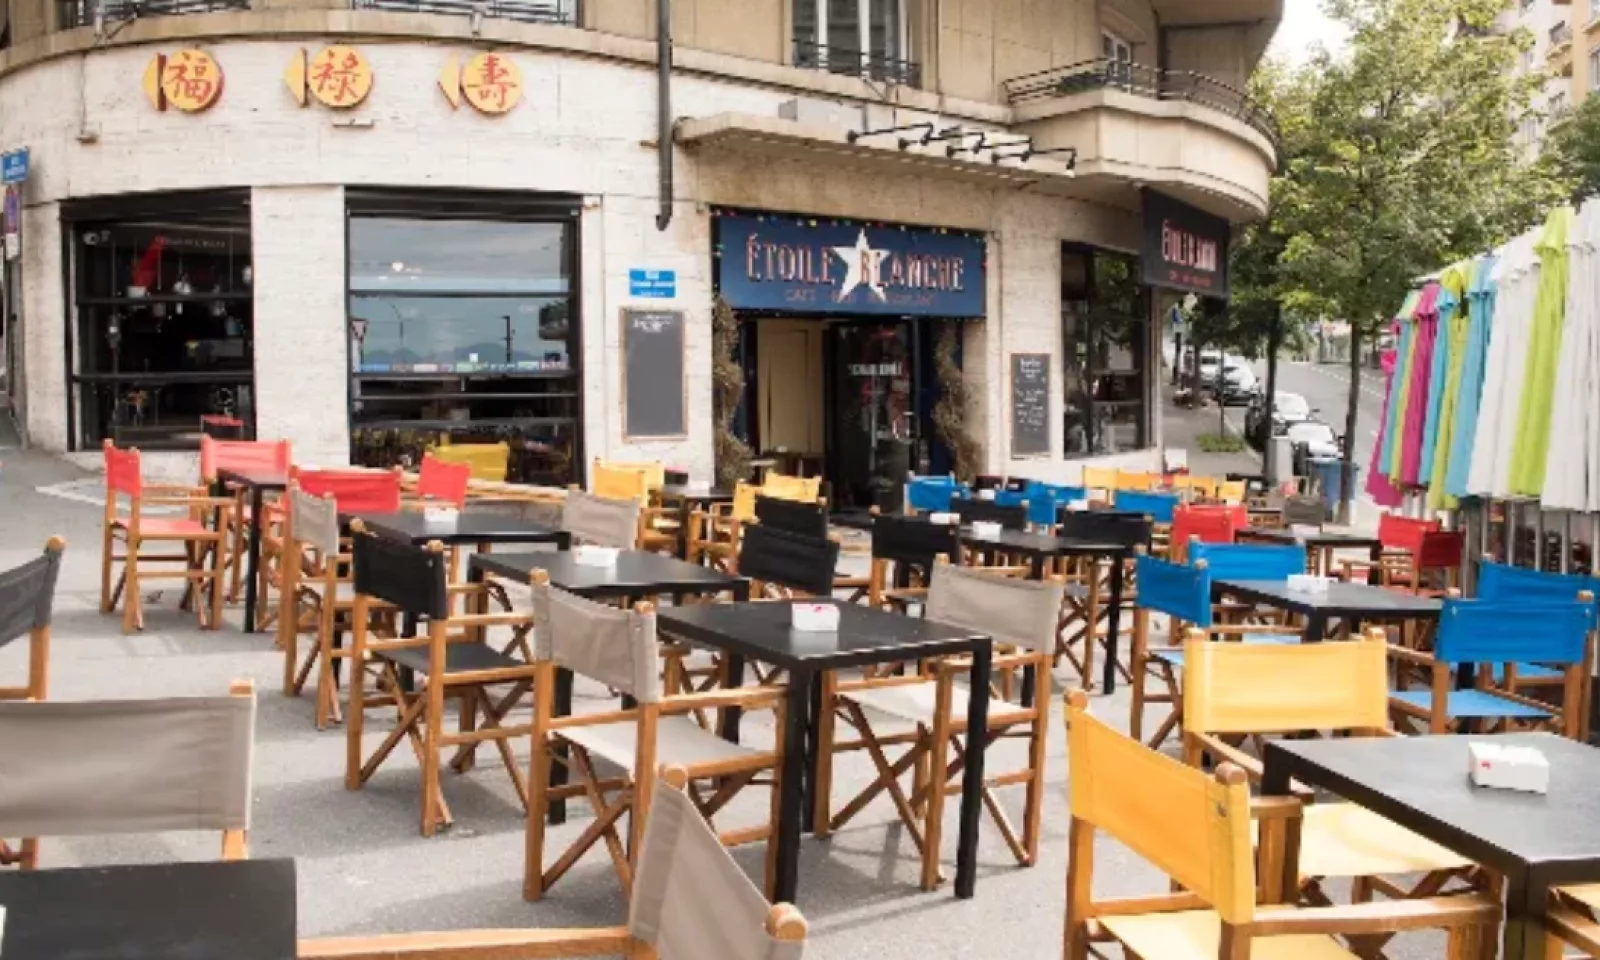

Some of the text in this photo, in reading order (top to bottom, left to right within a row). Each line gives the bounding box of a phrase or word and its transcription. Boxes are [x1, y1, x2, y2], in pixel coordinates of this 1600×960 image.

[166, 52, 212, 103] 福
[745, 231, 965, 291] ÉTOILE BLANCHE
